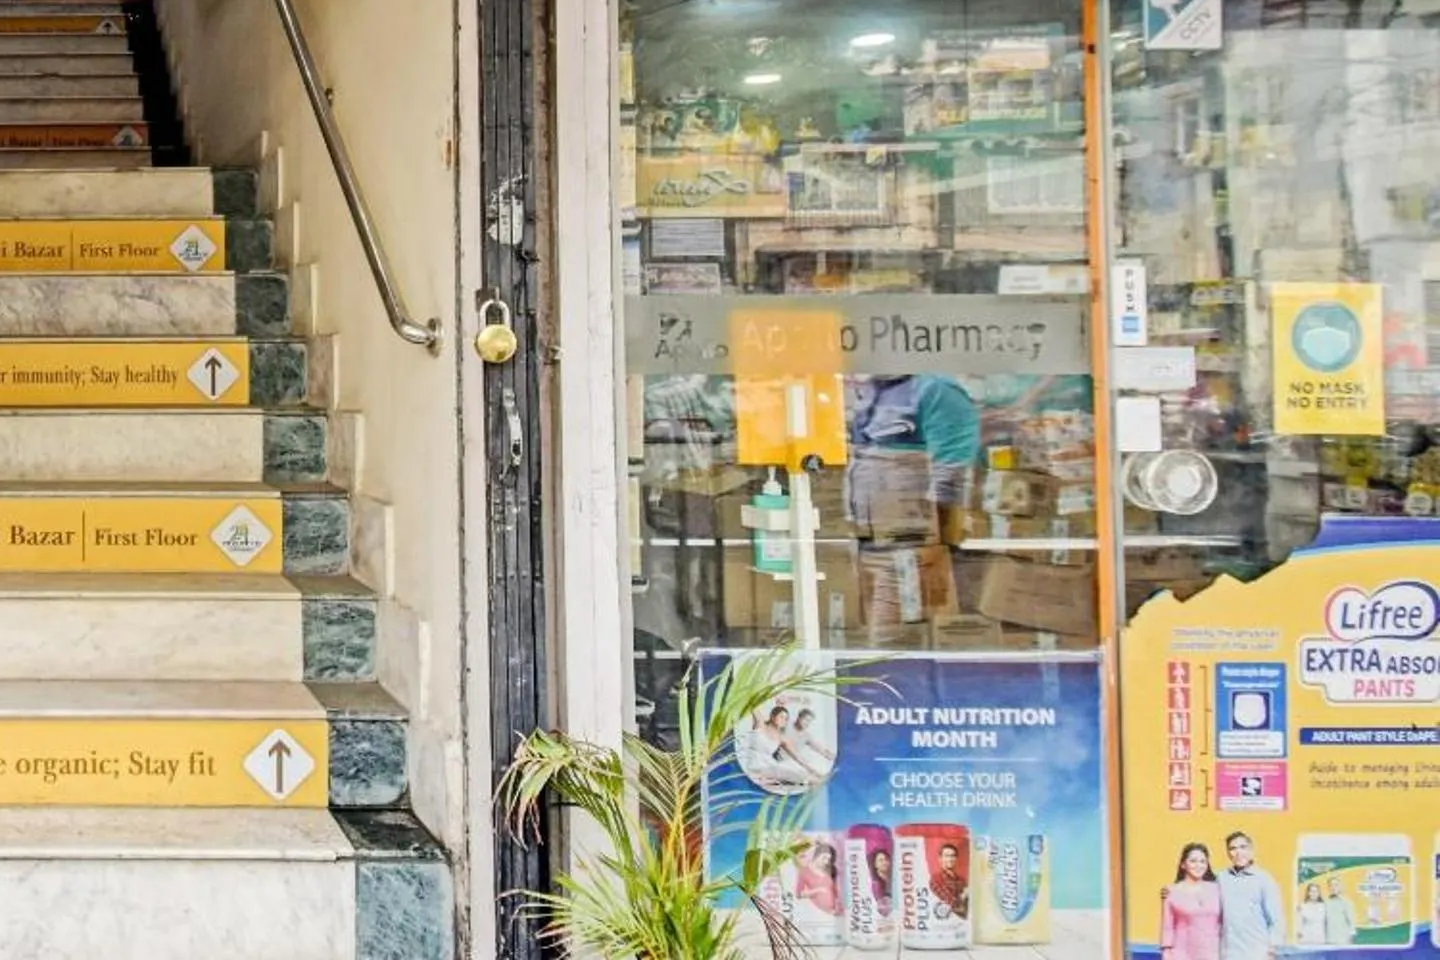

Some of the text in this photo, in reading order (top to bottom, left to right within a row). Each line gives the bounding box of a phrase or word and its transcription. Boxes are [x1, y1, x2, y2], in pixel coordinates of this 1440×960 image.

[14, 241, 65, 258] Bazar
[79, 243, 112, 258] First
[118, 243, 160, 258] Floor
[12, 365, 86, 388] immunity;
[91, 365, 120, 386] Stay
[125, 365, 179, 386] healthy
[1289, 381, 1365, 394] NO MASK
[1286, 396, 1367, 409] NO ENTRY
[9, 524, 75, 546] Bazar
[94, 527, 137, 546] First
[144, 527, 198, 546] Floor
[1341, 600, 1423, 629] Lifree
[1305, 647, 1382, 672] EXTRA
[1386, 655, 1440, 675] ABSO
[1353, 679, 1415, 698] PANTS
[855, 707, 1056, 725] ADULT NUTRITION
[911, 730, 998, 748] MONTH
[15, 750, 120, 784] organic;
[128, 750, 180, 783] Stay
[188, 750, 216, 776] fit
[888, 772, 1017, 789] CHOOSE YOUR
[890, 792, 1017, 808] HEALTH DRINK
[900, 850, 916, 930] Protein
[862, 896, 873, 935] PLUS
[917, 886, 929, 931] PLUS
